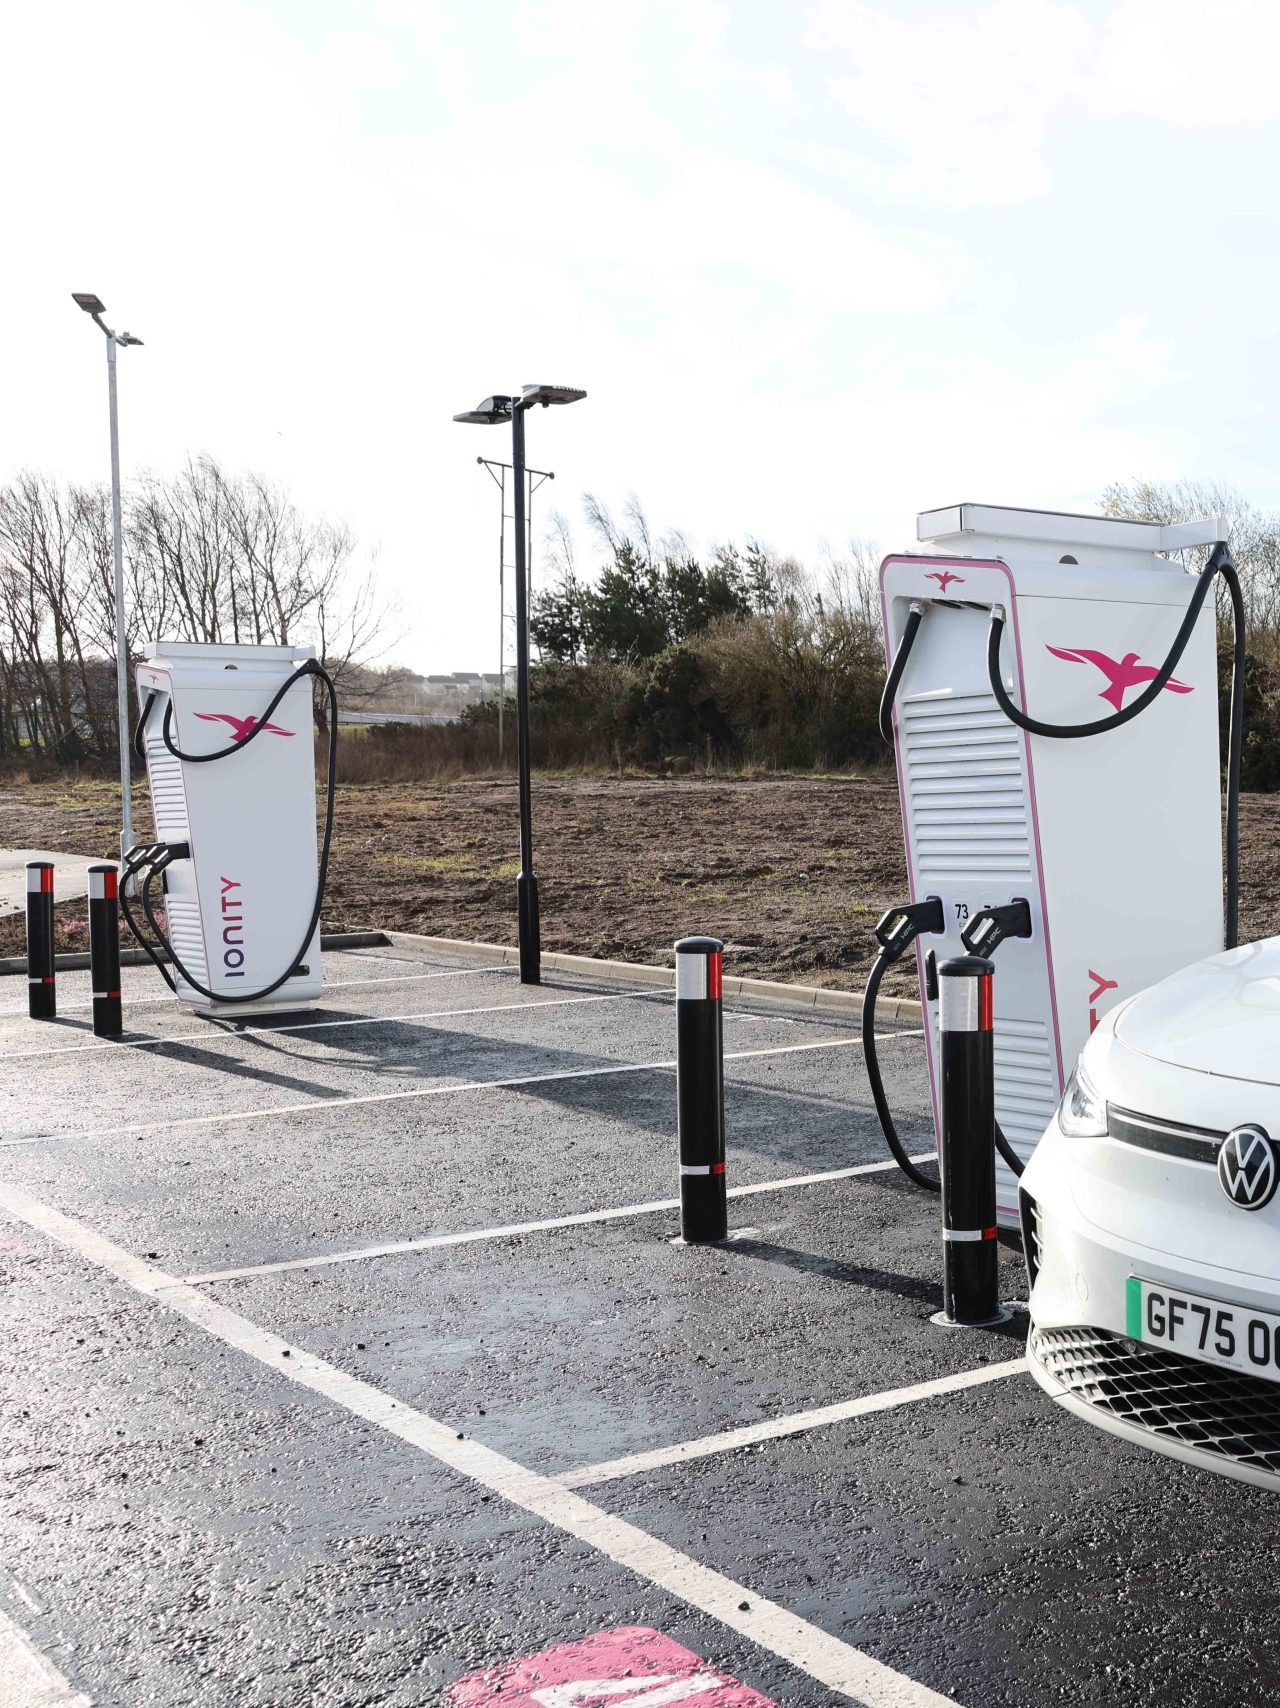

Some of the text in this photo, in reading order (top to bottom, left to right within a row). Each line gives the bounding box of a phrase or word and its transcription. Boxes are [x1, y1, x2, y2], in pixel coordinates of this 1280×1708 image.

[955, 904, 969, 919] 73
[220, 876, 245, 977] IONITY
[900, 923, 915, 940] HPC
[986, 927, 1002, 944] HPC
[1147, 1292, 1236, 1358] GF75
